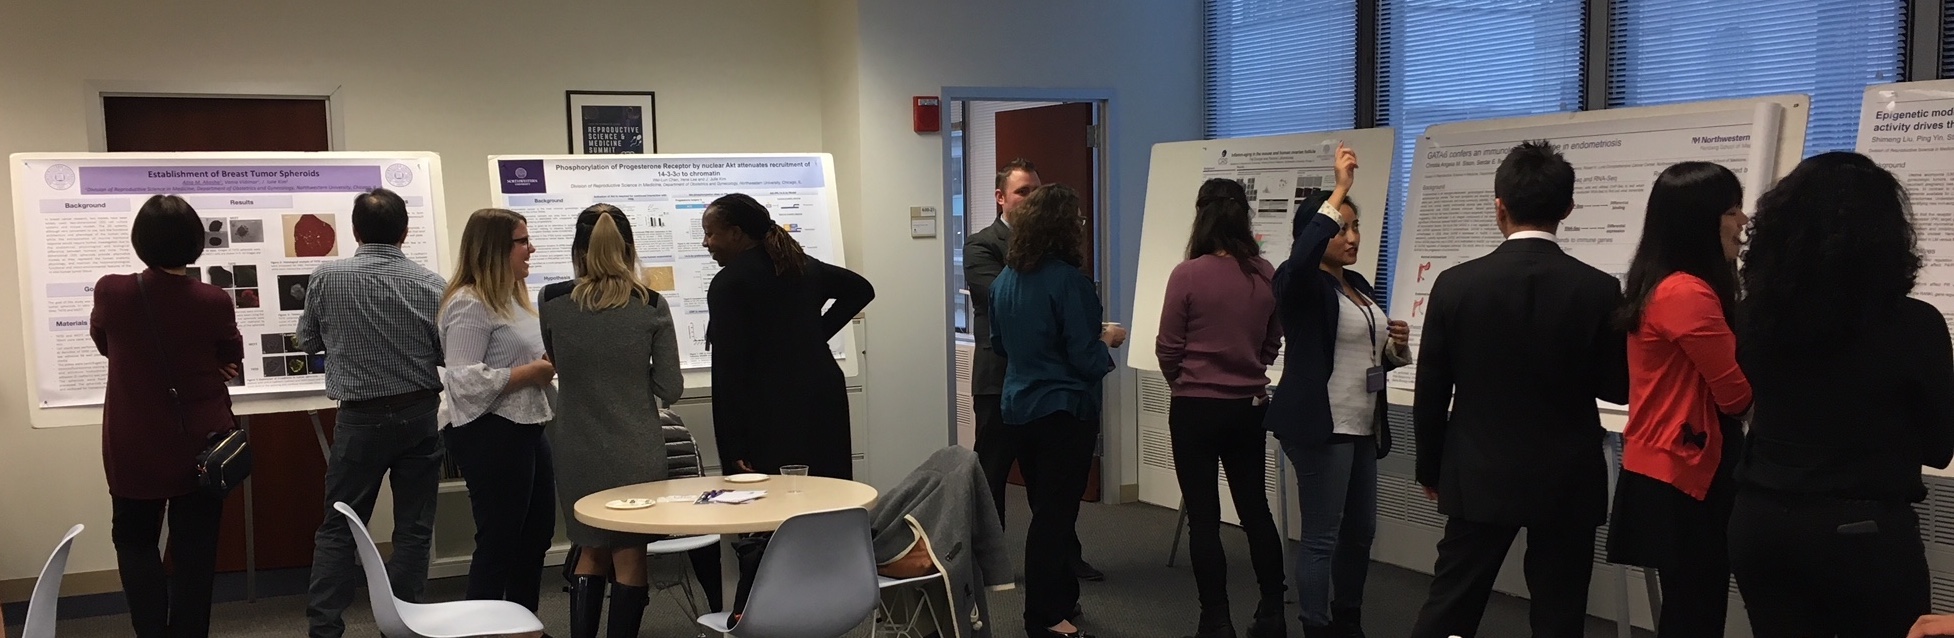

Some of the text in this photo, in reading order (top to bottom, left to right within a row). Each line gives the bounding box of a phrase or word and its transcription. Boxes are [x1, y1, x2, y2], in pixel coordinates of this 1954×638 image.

[1876, 108, 1954, 120] Epigenetic mod
[1874, 123, 1910, 132] activity
[1914, 122, 1944, 130] drives
[1701, 134, 1750, 144] Northwestern
[1449, 150, 1472, 158] confers
[1570, 140, 1622, 150] endometriosis
[280, 170, 320, 178] Spheroids
